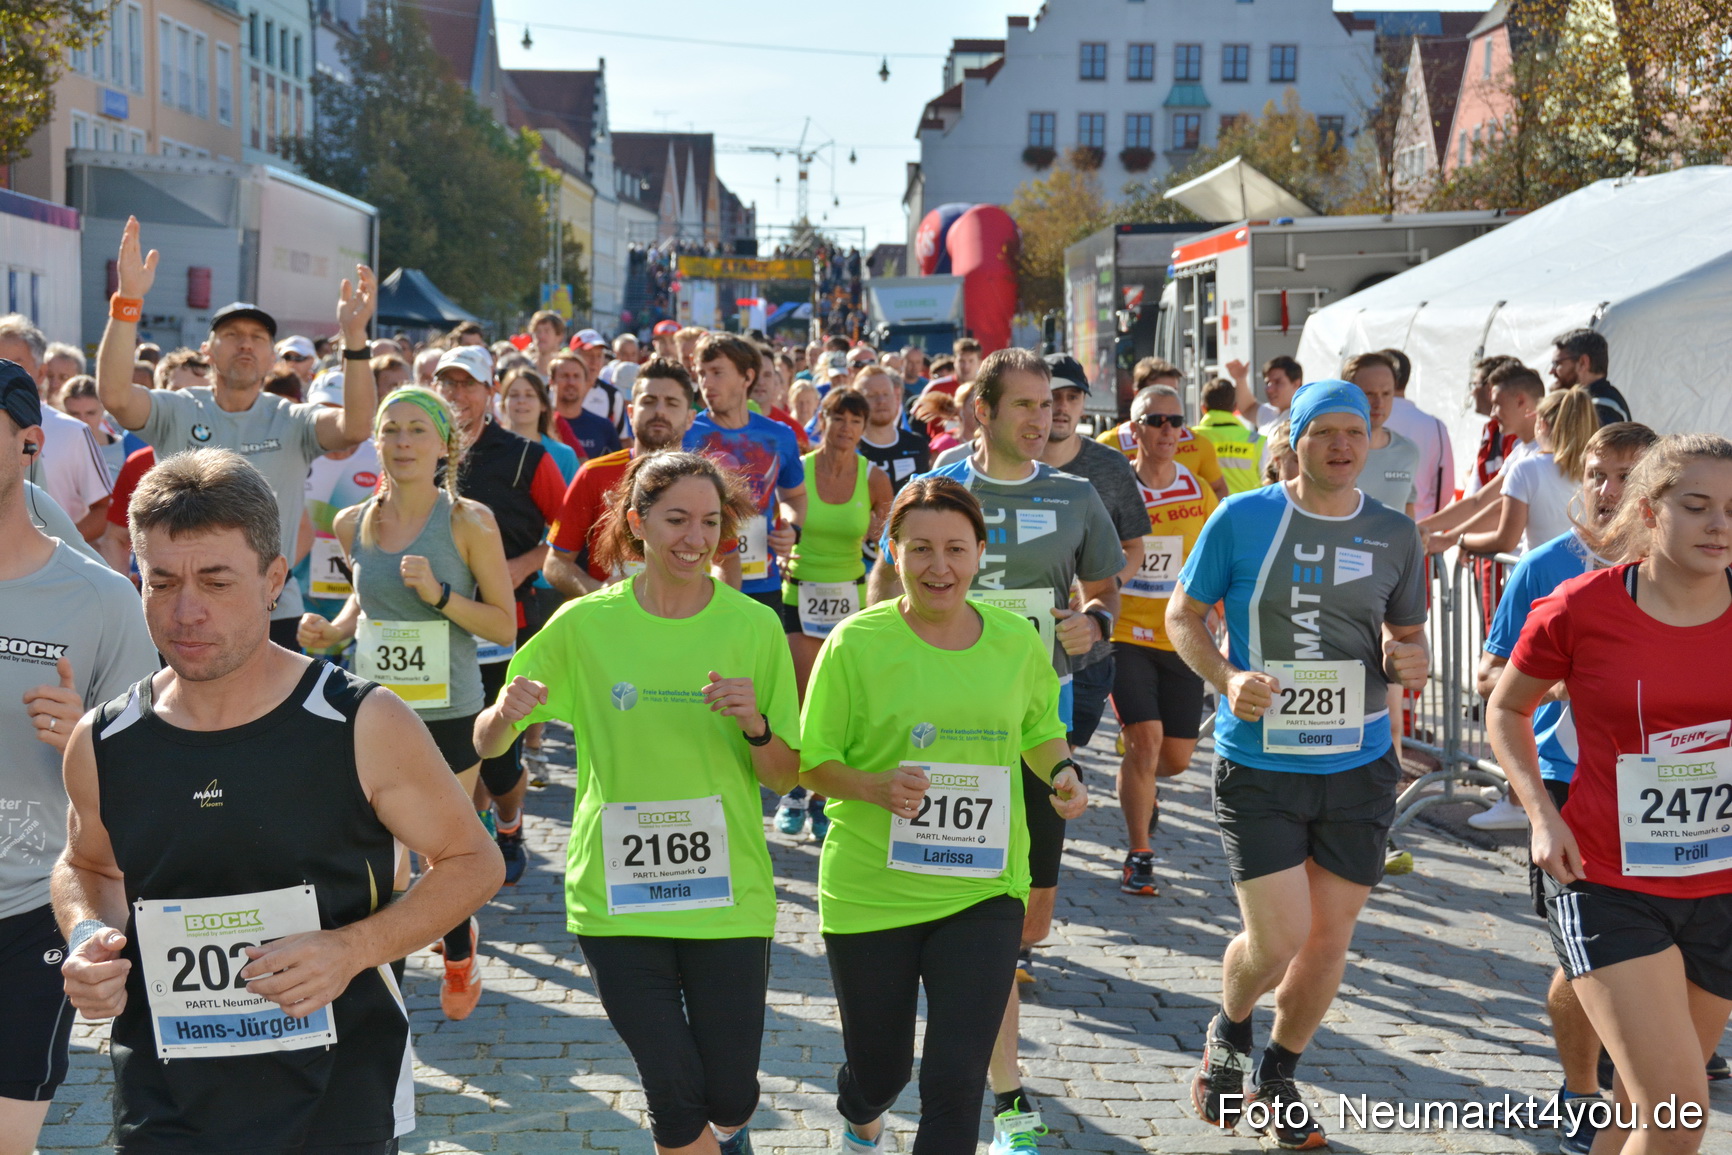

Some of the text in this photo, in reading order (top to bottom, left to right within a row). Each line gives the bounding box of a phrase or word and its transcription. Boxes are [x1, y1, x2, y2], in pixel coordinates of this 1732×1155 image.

[978, 508, 1007, 590] ATEC
[1133, 580, 1164, 591] Andreas
[807, 598, 850, 615] 2478
[1291, 543, 1325, 659] MATEC
[382, 628, 421, 639] BOCK
[376, 646, 425, 671] 334
[1294, 670, 1338, 681] BOCK
[1280, 687, 1346, 715] 2281
[1299, 732, 1333, 746] Georg
[1671, 731, 1707, 748] DEHN
[1658, 762, 1717, 778] BOCK
[930, 774, 979, 787] BOCK
[193, 789, 223, 799] MAUI
[1640, 784, 1732, 823] 2472
[638, 811, 691, 824] BOCK
[909, 795, 993, 830] 2167
[24, 820, 40, 836] 2018
[1651, 828, 1719, 838] PARTL Neumarkt
[916, 832, 976, 842] PARTL Neumarkt
[622, 831, 711, 866] 2168
[923, 848, 974, 864] Larissa
[1674, 843, 1708, 861] Pröll
[660, 868, 695, 877] Neumarkt
[650, 884, 691, 900] Maria
[184, 909, 263, 931] BOCK
[156, 984, 162, 993] C
[186, 1000, 220, 1009] PARTL
[176, 1014, 309, 1040] Hans-Jürgen
